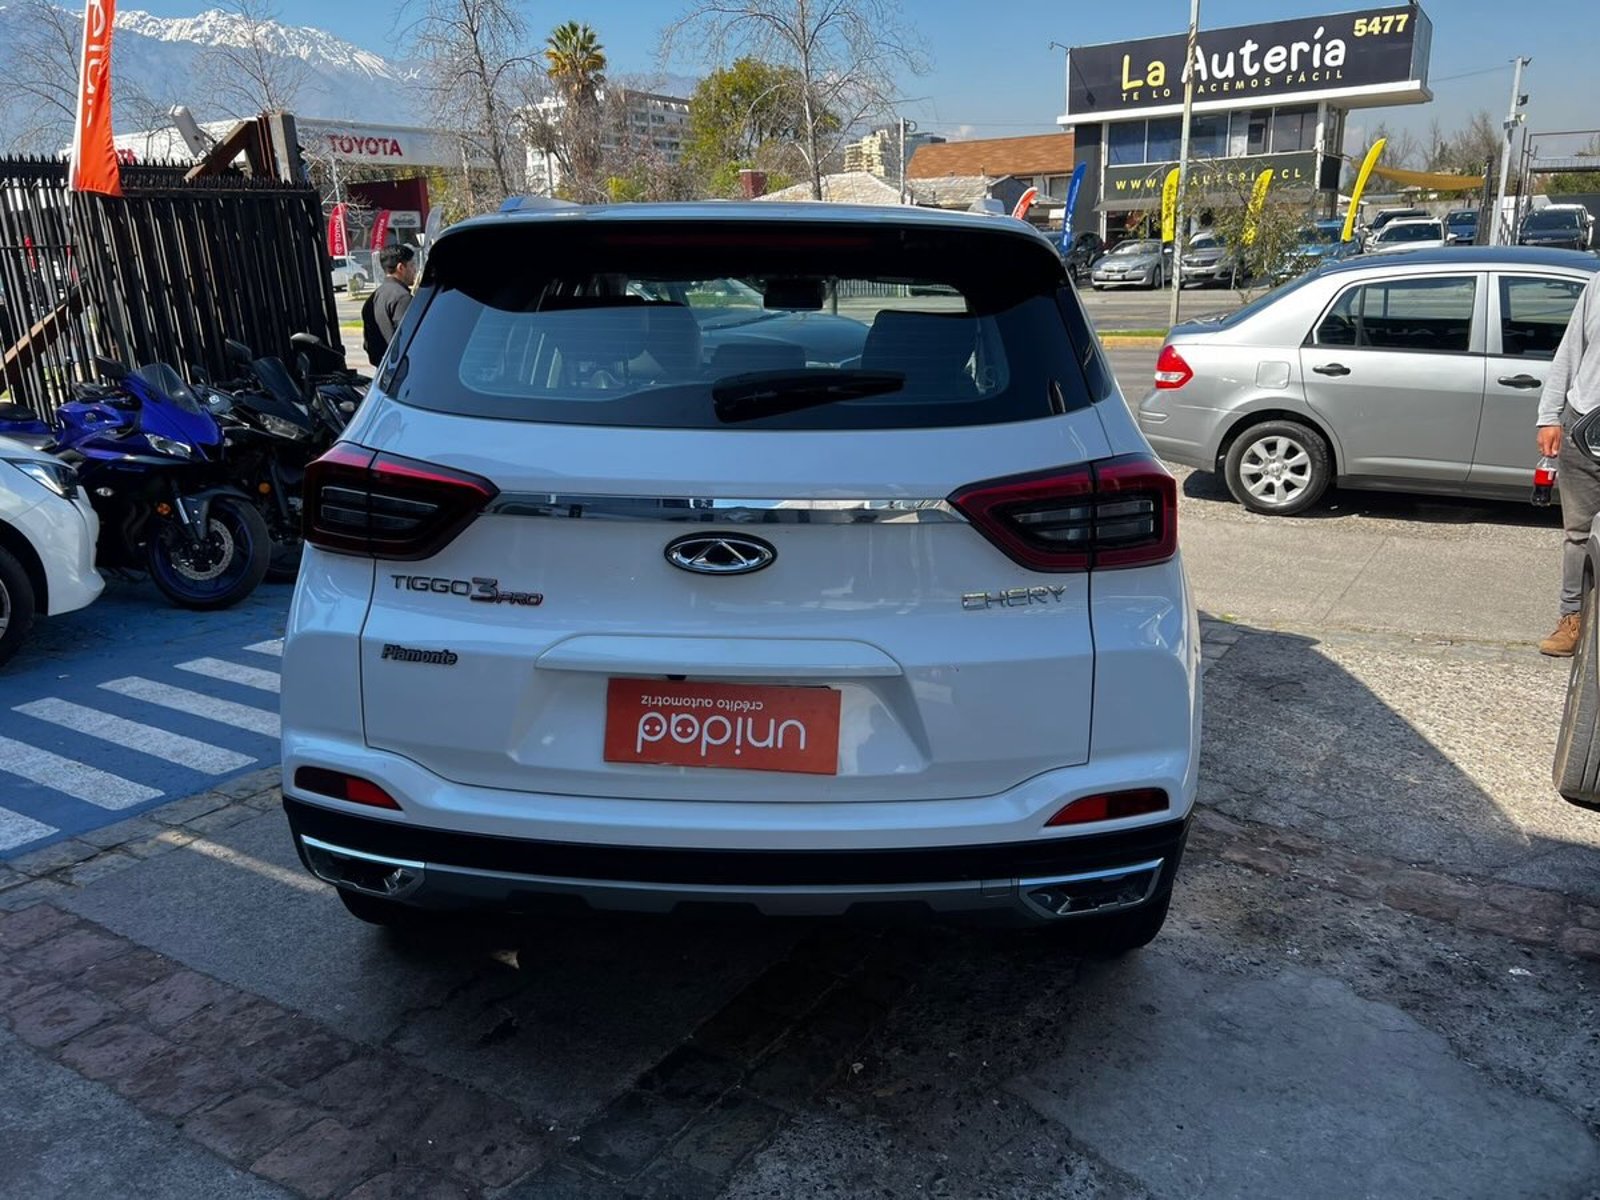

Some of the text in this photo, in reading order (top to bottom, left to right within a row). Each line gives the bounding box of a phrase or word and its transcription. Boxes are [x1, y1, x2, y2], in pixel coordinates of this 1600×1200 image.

[1353, 14, 1409, 38] 5477
[1121, 26, 1347, 91] La Autería
[1121, 69, 1344, 102] TE LO ACEMOS FÁCIL
[328, 135, 403, 157] TOYOTA
[961, 585, 1067, 611] CHERY
[381, 643, 459, 666] Piamonte
[641, 695, 764, 713] crédito automotriz
[636, 711, 807, 757] unidad
